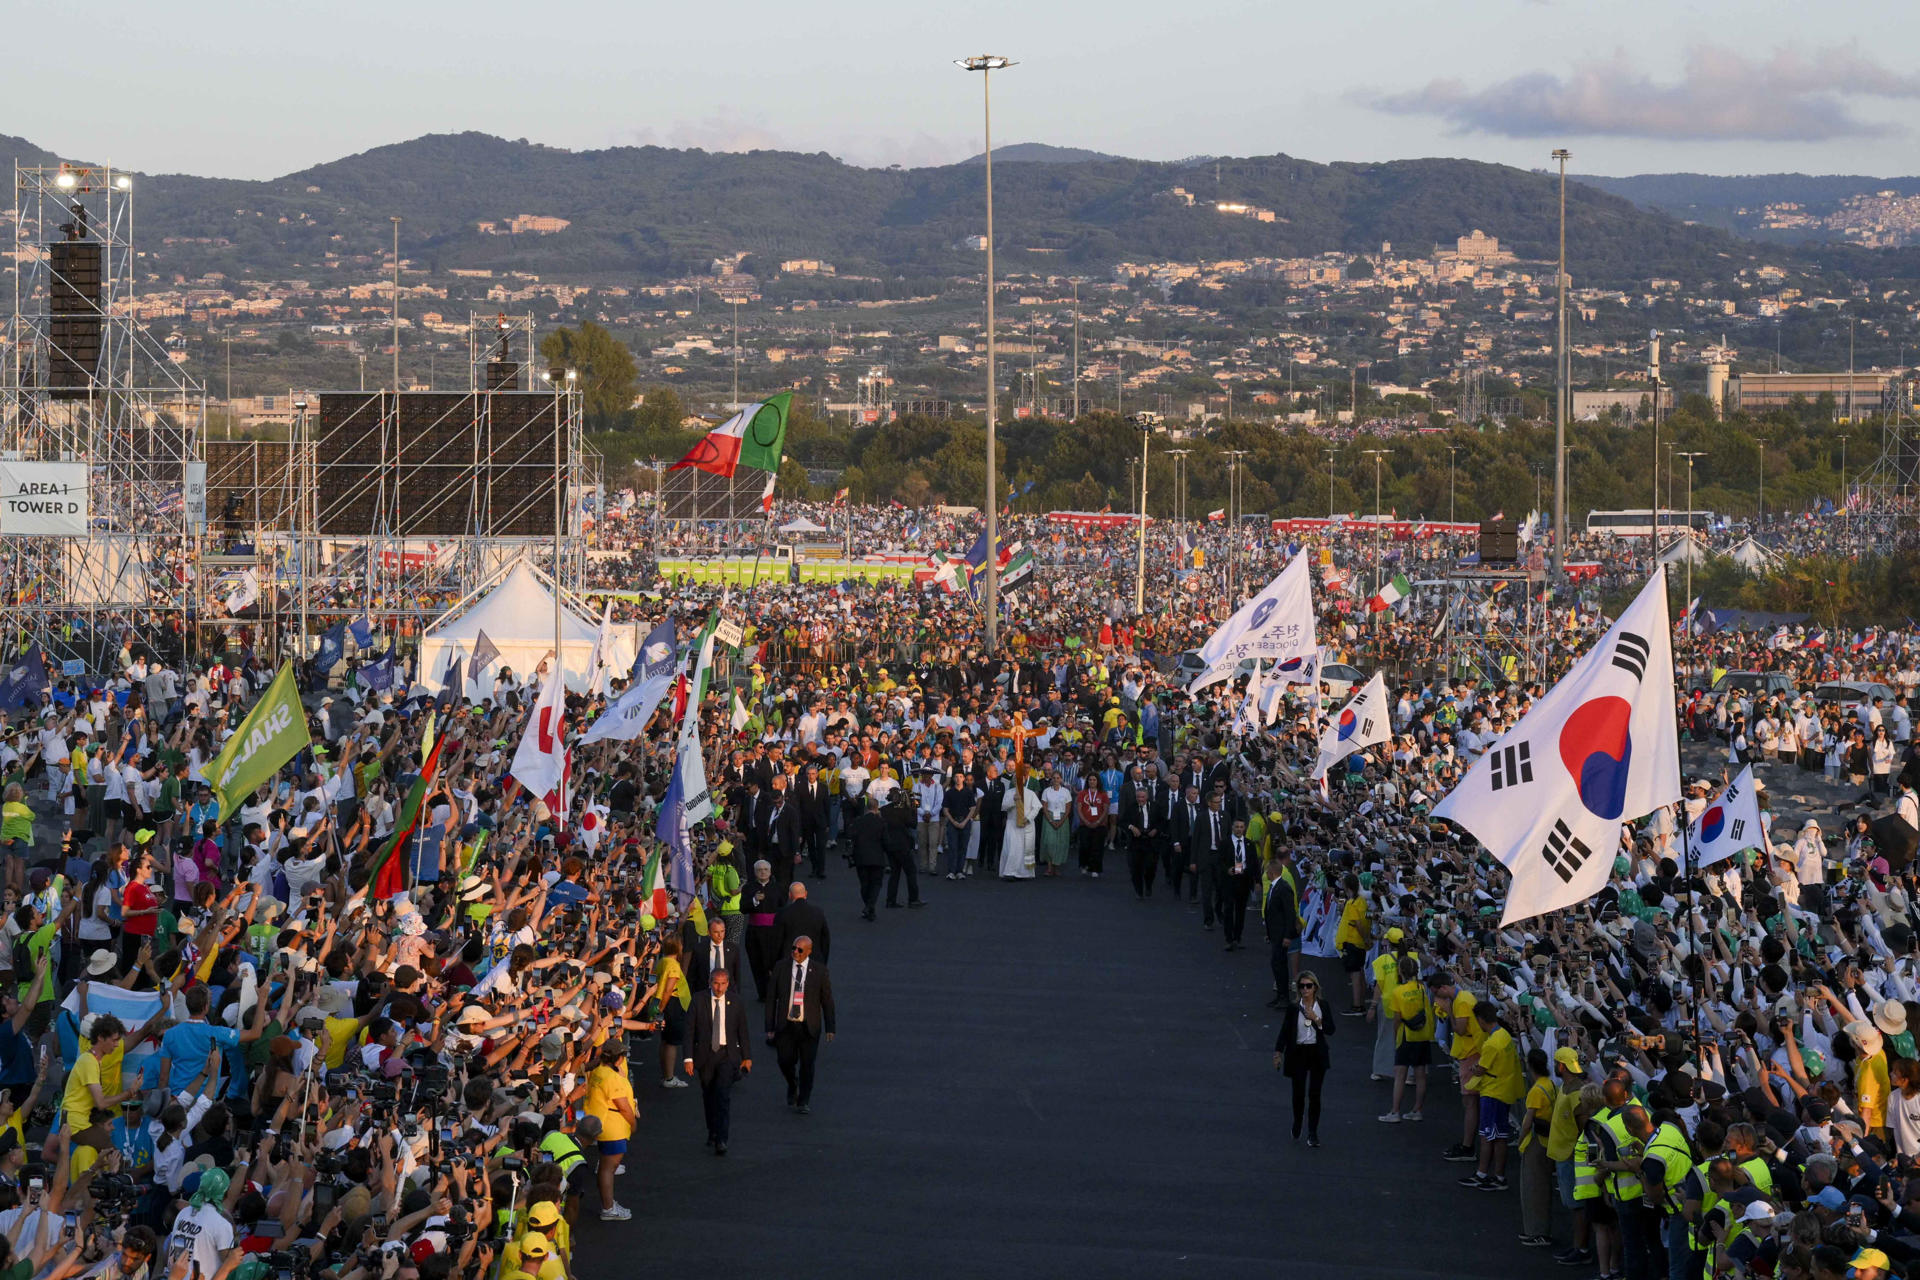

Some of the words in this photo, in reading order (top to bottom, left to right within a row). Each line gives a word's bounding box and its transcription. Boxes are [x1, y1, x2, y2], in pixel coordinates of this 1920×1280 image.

[18, 482, 59, 495] AREA
[63, 483, 68, 494] 1
[9, 500, 63, 514] TOWER
[67, 502, 79, 514] D
